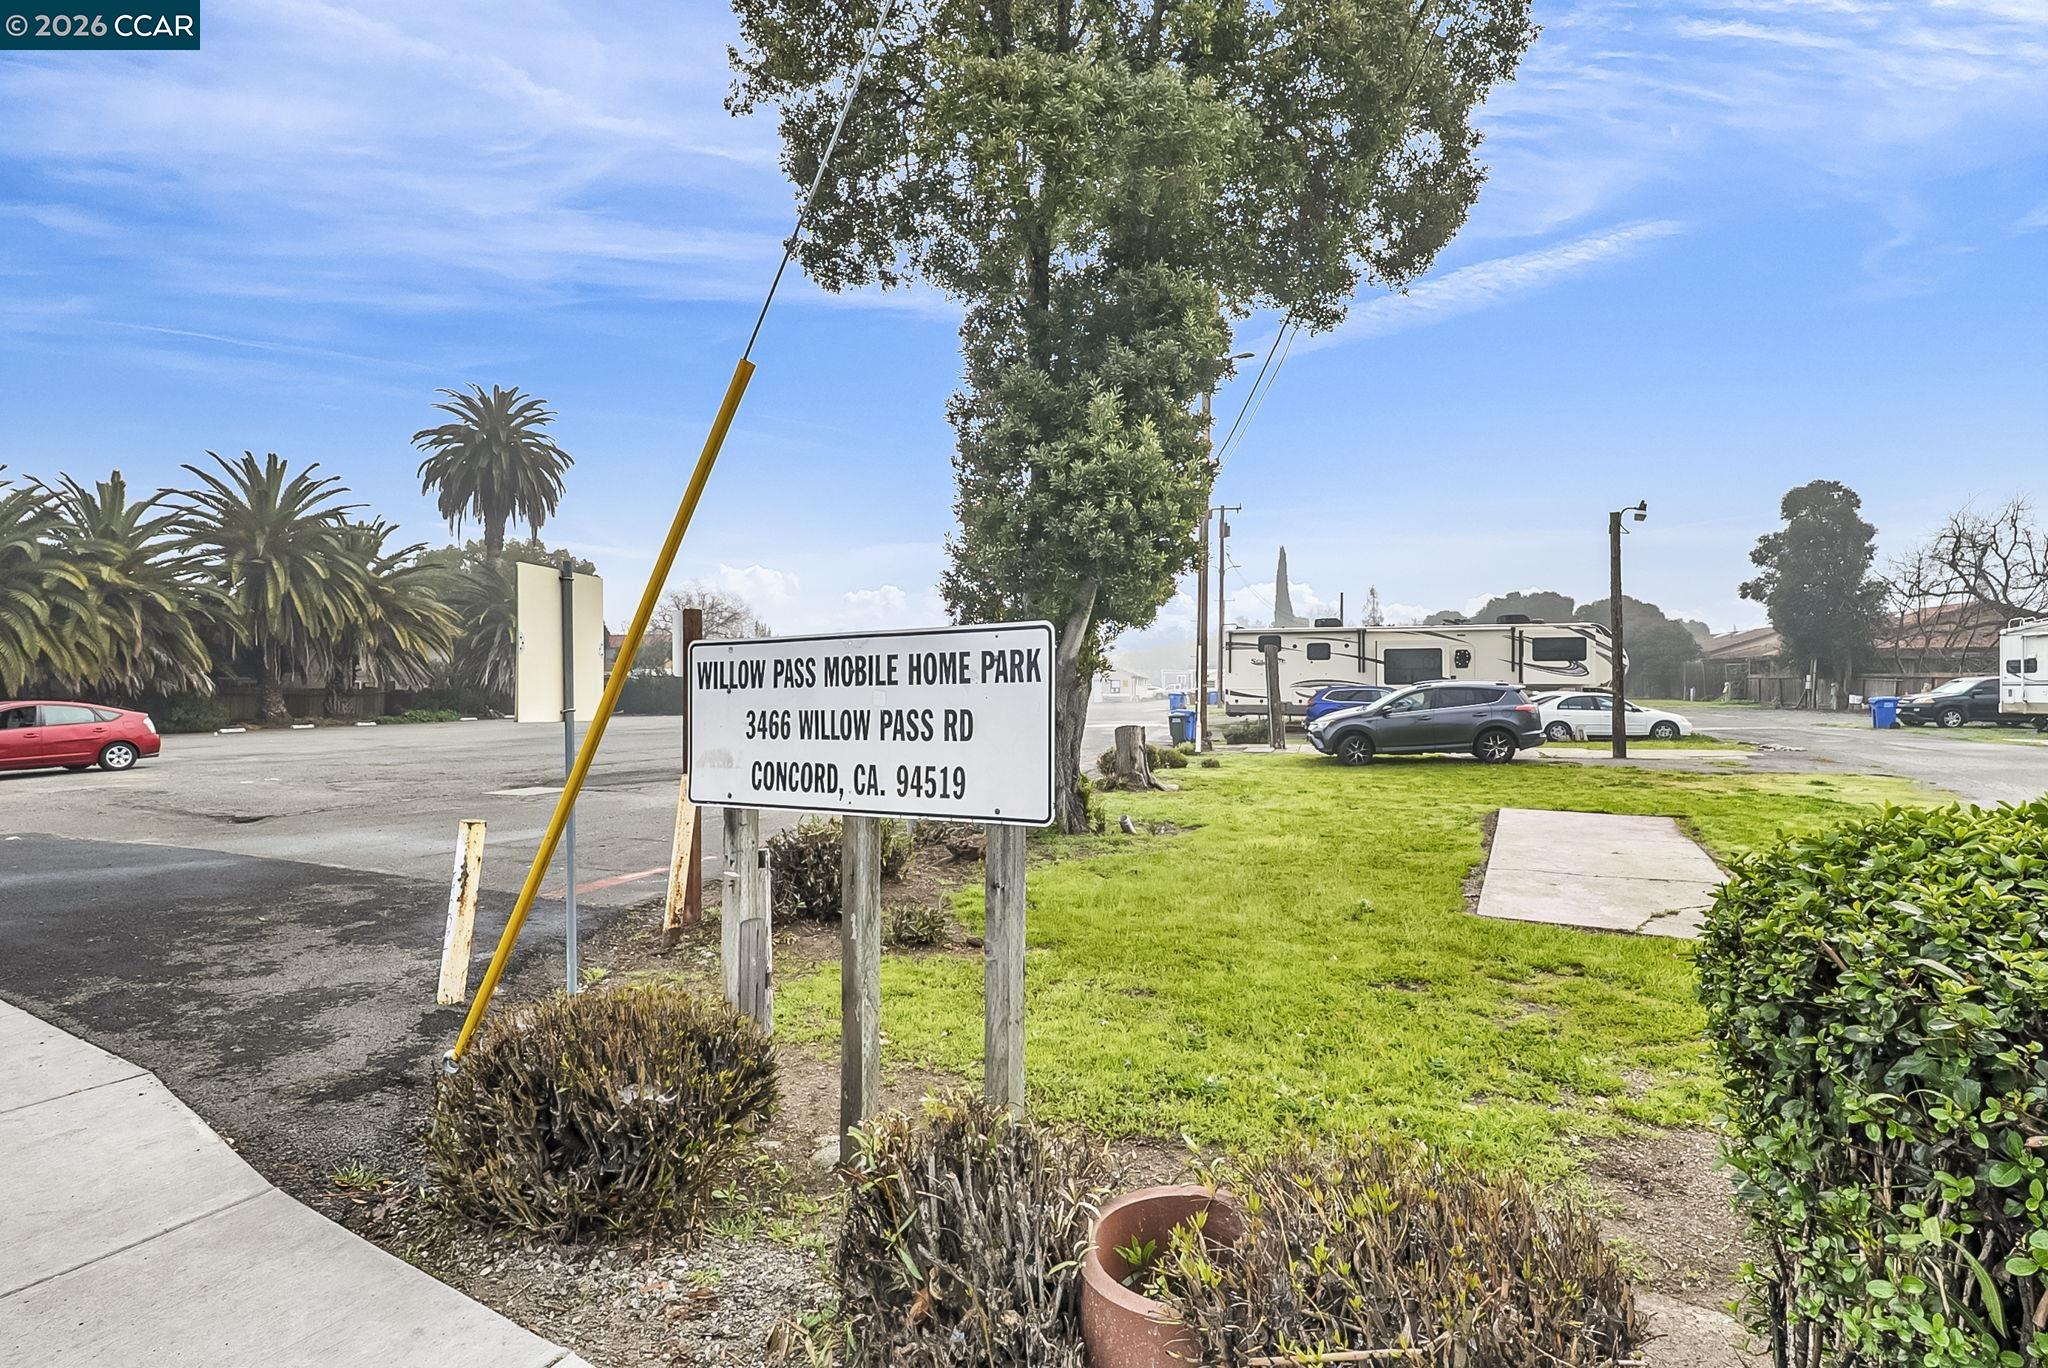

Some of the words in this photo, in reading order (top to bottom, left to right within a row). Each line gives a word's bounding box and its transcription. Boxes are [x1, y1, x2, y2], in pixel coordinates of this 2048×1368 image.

[697, 660, 766, 690] WILLOW
[773, 657, 816, 689] PASS
[824, 654, 898, 688] MOBILE
[908, 650, 971, 686] HOME
[981, 648, 1042, 684] PARK
[745, 709, 791, 740] 3466
[798, 709, 871, 741] WILLOW
[880, 709, 934, 742] PASS
[944, 709, 974, 742] RD
[751, 760, 844, 800] CONCORD,
[853, 763, 886, 796] CA.
[896, 765, 966, 800] 94519
